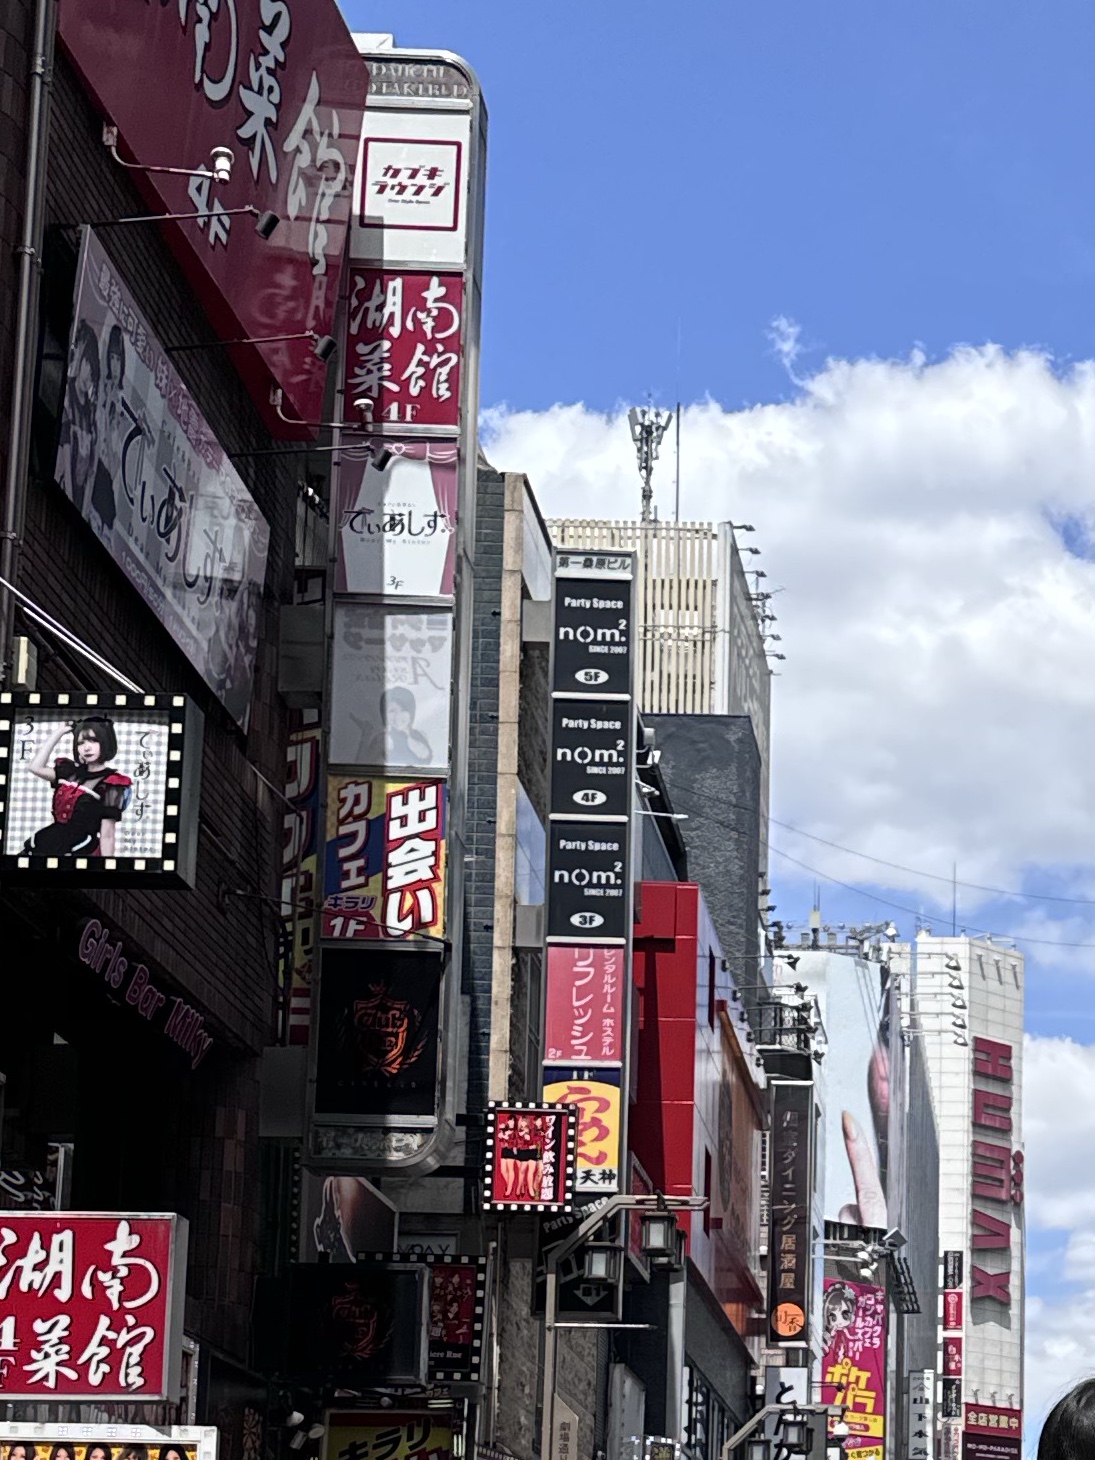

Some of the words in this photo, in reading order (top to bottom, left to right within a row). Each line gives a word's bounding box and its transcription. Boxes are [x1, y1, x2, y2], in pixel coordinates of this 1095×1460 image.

[382, 164, 444, 180] カブキ
[372, 181, 450, 197] ラウンジ
[381, 403, 421, 422] 4F
[564, 597, 591, 609] Party
[592, 598, 623, 609] Space
[583, 671, 601, 682] 5F
[562, 718, 589, 730] Party
[590, 719, 621, 730] Space
[20, 716, 35, 761] 3F
[581, 792, 598, 803] 4F
[337, 780, 373, 890] カフェ
[559, 840, 586, 851] Party
[588, 841, 619, 851] Space
[384, 782, 440, 938] 出会い
[578, 915, 596, 926] 3F
[602, 949, 617, 1013] レンタルルーム
[79, 917, 128, 989] Girls
[125, 962, 166, 1020] Bar
[163, 996, 214, 1069] Milky
[570, 947, 595, 1060] リフレッシュ
[600, 1017, 616, 1057] ホステル
[548, 1048, 563, 1059] 2F
[544, 1114, 556, 1149] ワイン
[579, 1169, 616, 1186] 天神
[542, 1215, 574, 1234] Party
[872, 1291, 885, 1348] キャバクラ
[22, 1313, 155, 1393] 菜館
